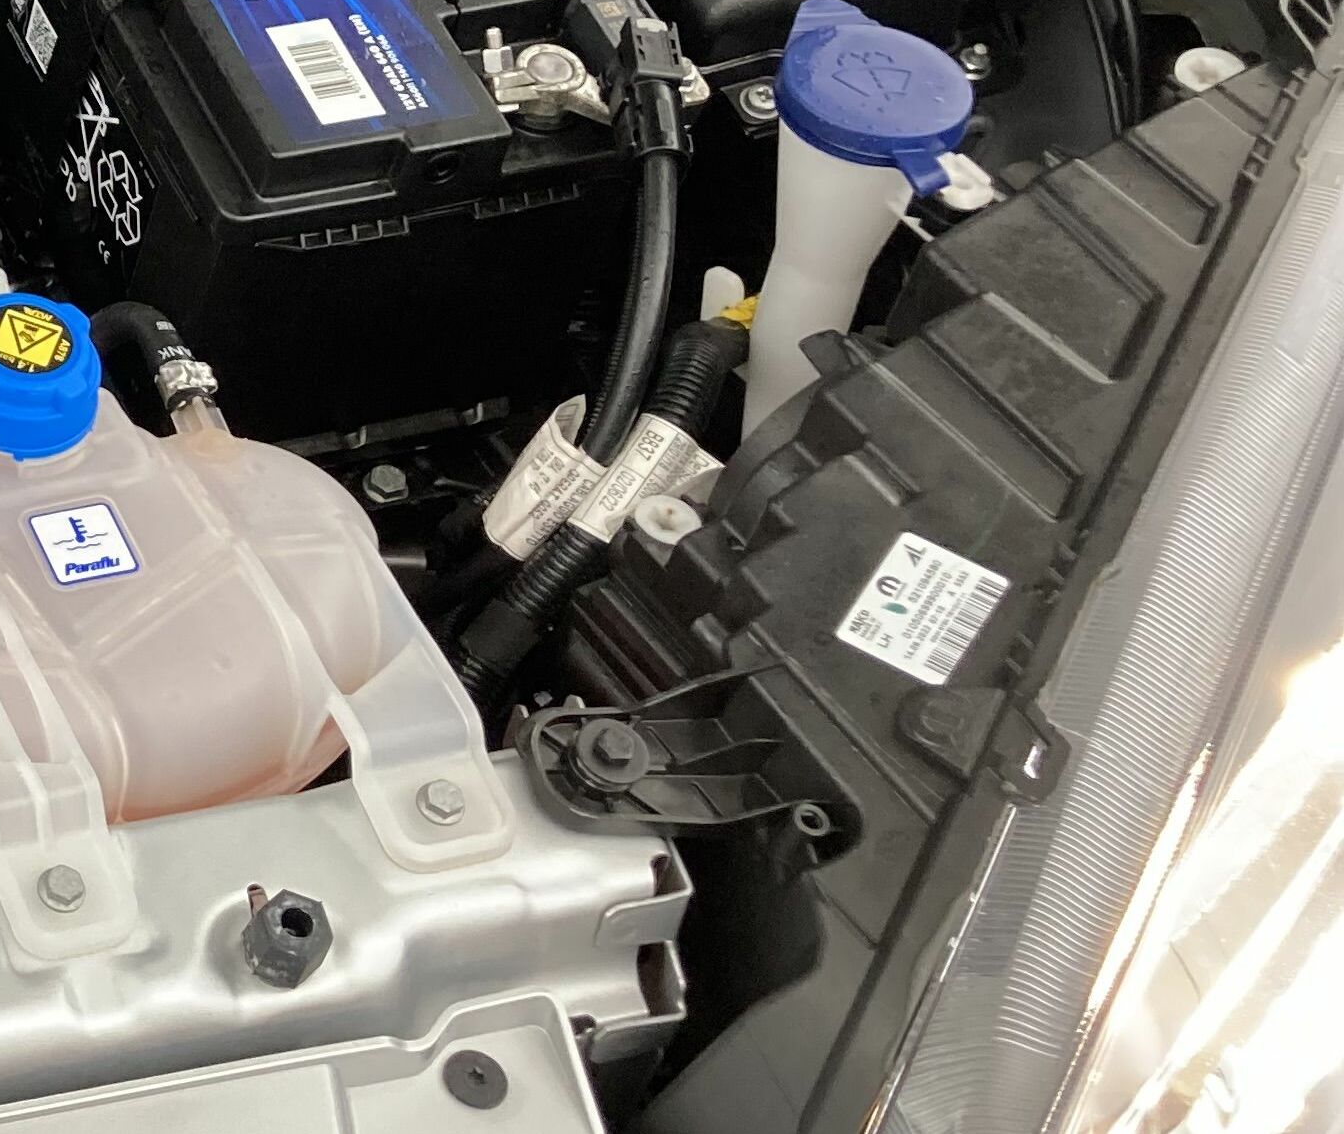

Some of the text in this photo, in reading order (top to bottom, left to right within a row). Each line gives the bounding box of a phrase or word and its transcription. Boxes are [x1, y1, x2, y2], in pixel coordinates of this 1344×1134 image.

[633, 428, 664, 461] B837
[64, 555, 121, 577] Paraflu
[876, 631, 893, 649] LH
